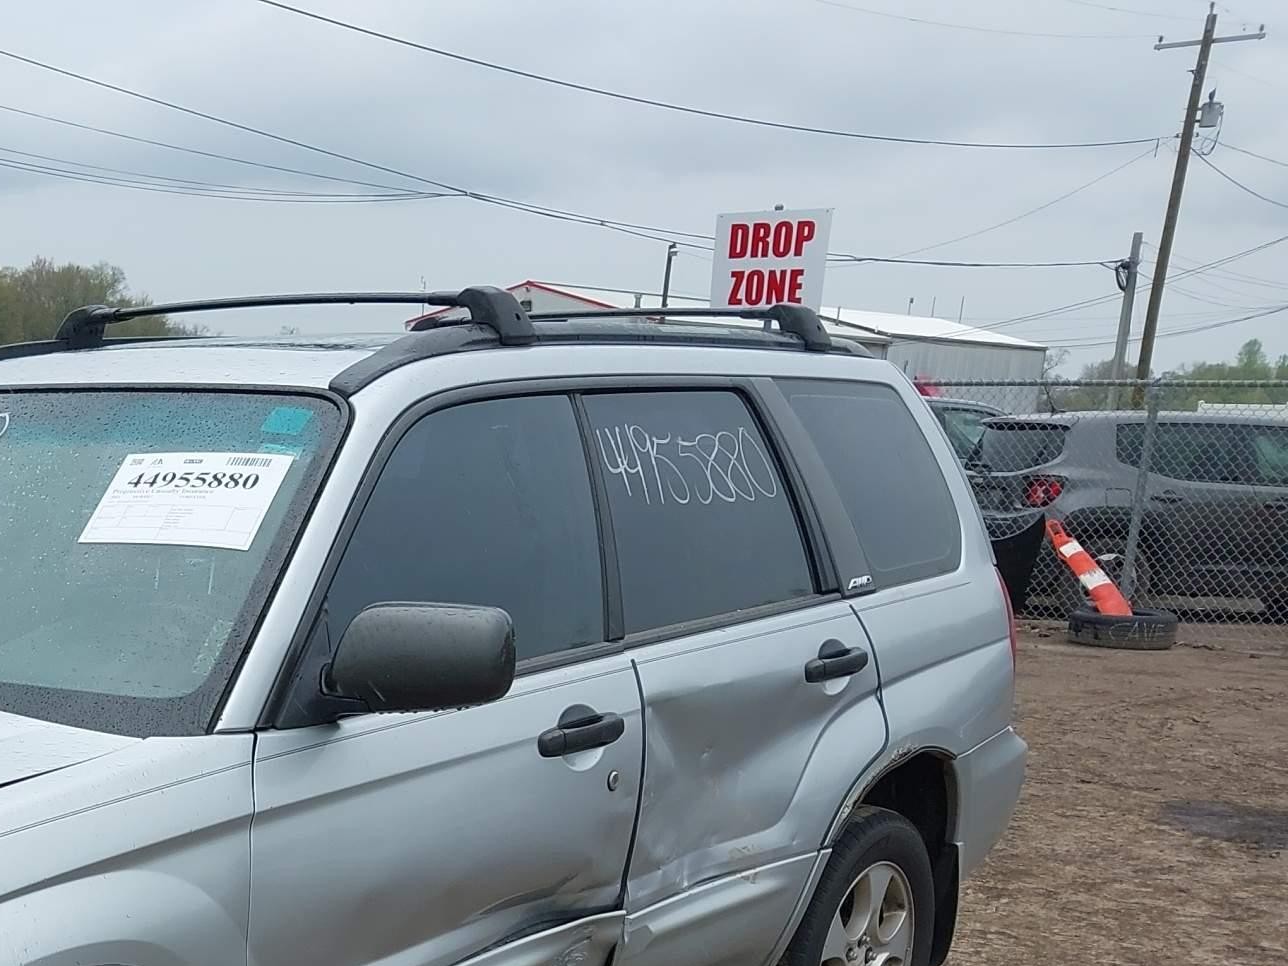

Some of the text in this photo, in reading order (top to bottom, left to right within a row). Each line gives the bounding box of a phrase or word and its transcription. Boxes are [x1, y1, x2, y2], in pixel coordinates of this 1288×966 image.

[727, 219, 816, 260] DROP
[727, 268, 805, 306] ZONE
[127, 471, 260, 490] 44955880
[596, 423, 777, 505] 44955880
